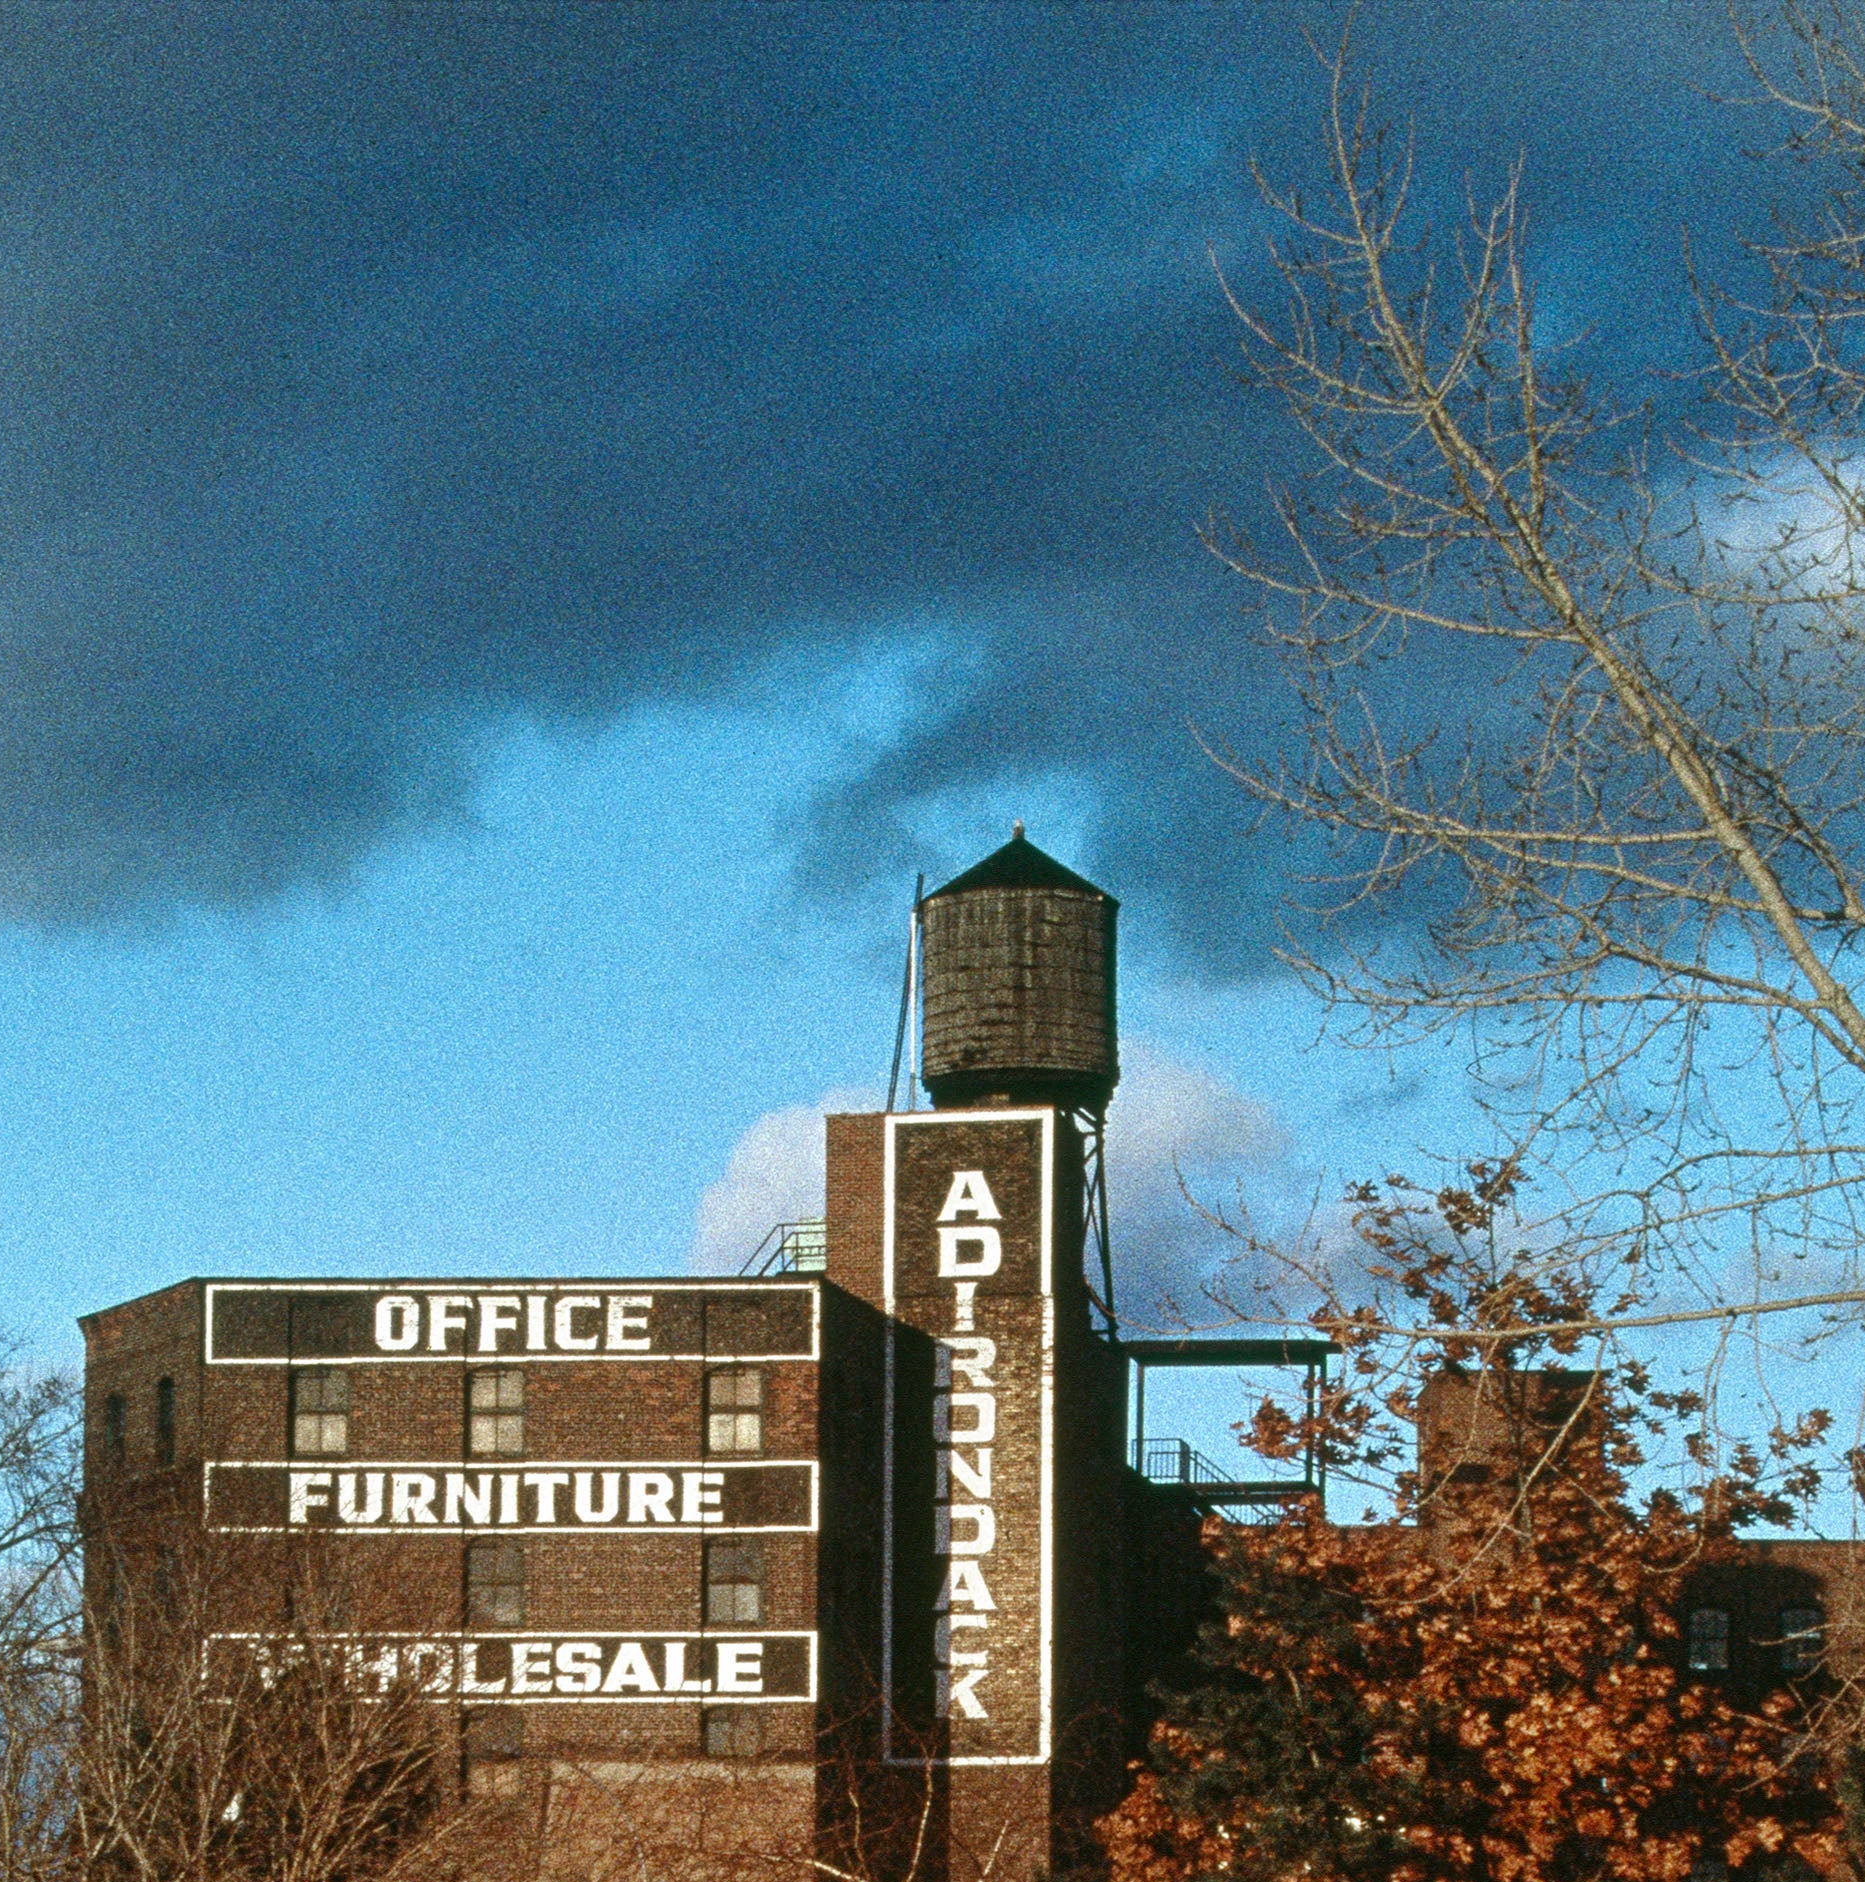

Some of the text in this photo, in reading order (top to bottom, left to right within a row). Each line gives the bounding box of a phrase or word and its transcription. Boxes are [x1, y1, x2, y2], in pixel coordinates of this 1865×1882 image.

[375, 1295, 653, 1351] OFFICE
[933, 1171, 1003, 1719] ADIRONDACK
[288, 1472, 725, 1525] FURNITURE
